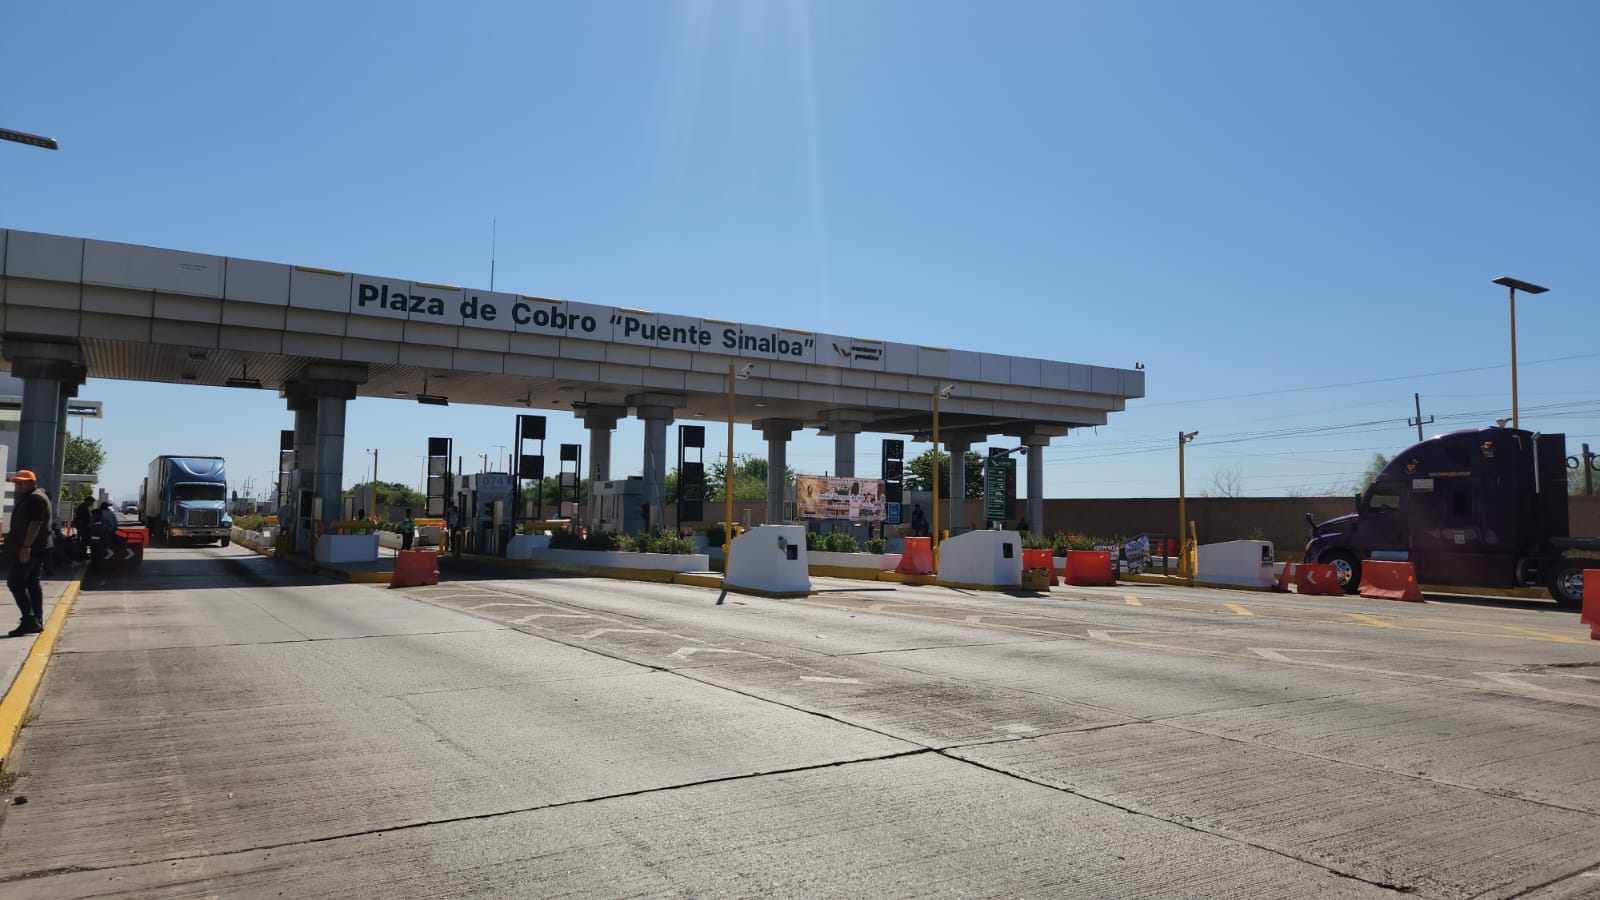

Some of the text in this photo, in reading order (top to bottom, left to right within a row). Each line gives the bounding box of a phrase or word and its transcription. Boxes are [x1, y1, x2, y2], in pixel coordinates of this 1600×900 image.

[358, 284, 444, 315] Plaza
[460, 297, 497, 321] de
[512, 302, 596, 332] Cobro
